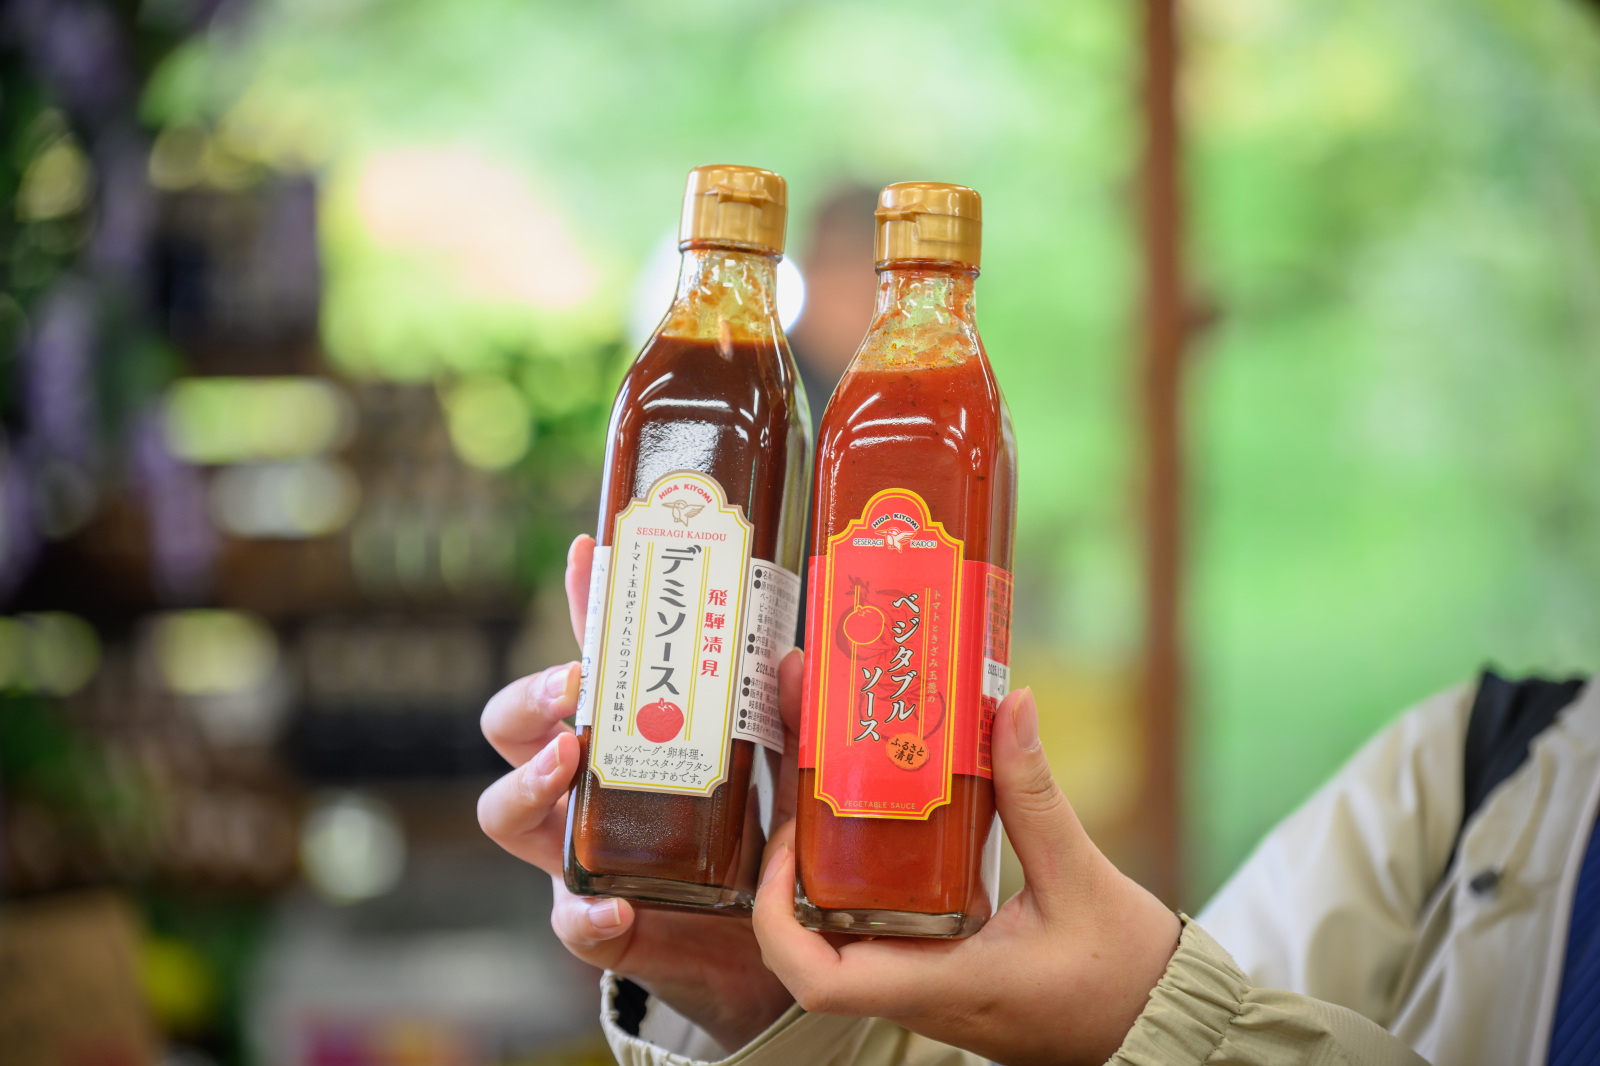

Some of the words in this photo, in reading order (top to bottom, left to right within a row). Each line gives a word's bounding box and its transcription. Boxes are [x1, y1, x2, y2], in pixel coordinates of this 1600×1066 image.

[658, 484, 679, 500] HIDA
[684, 483, 713, 504] KIYOMI
[872, 514, 891, 529] HIDA
[636, 527, 684, 539] SESERAGI
[687, 532, 727, 542] KAIDOU
[853, 538, 884, 546] SESERAGI
[910, 540, 937, 548] KAIDOU
[646, 544, 702, 696] デミソース
[612, 541, 641, 733] トマト・玉ねぎ・りんごのコク深い味わい
[700, 588, 728, 678] 飛騨清見
[927, 589, 942, 703] トマトときざみ玉葱の
[884, 593, 921, 723] ベジタブル
[853, 666, 883, 742] ソース
[890, 738, 925, 757] ふるさと
[894, 750, 914, 765] 清見
[603, 753, 713, 773] 揚げ物・パスタ・グラタン
[610, 766, 702, 785] などにおすすめです。
[843, 800, 888, 809] VEGETABLE
[890, 802, 917, 810] SAUCE
